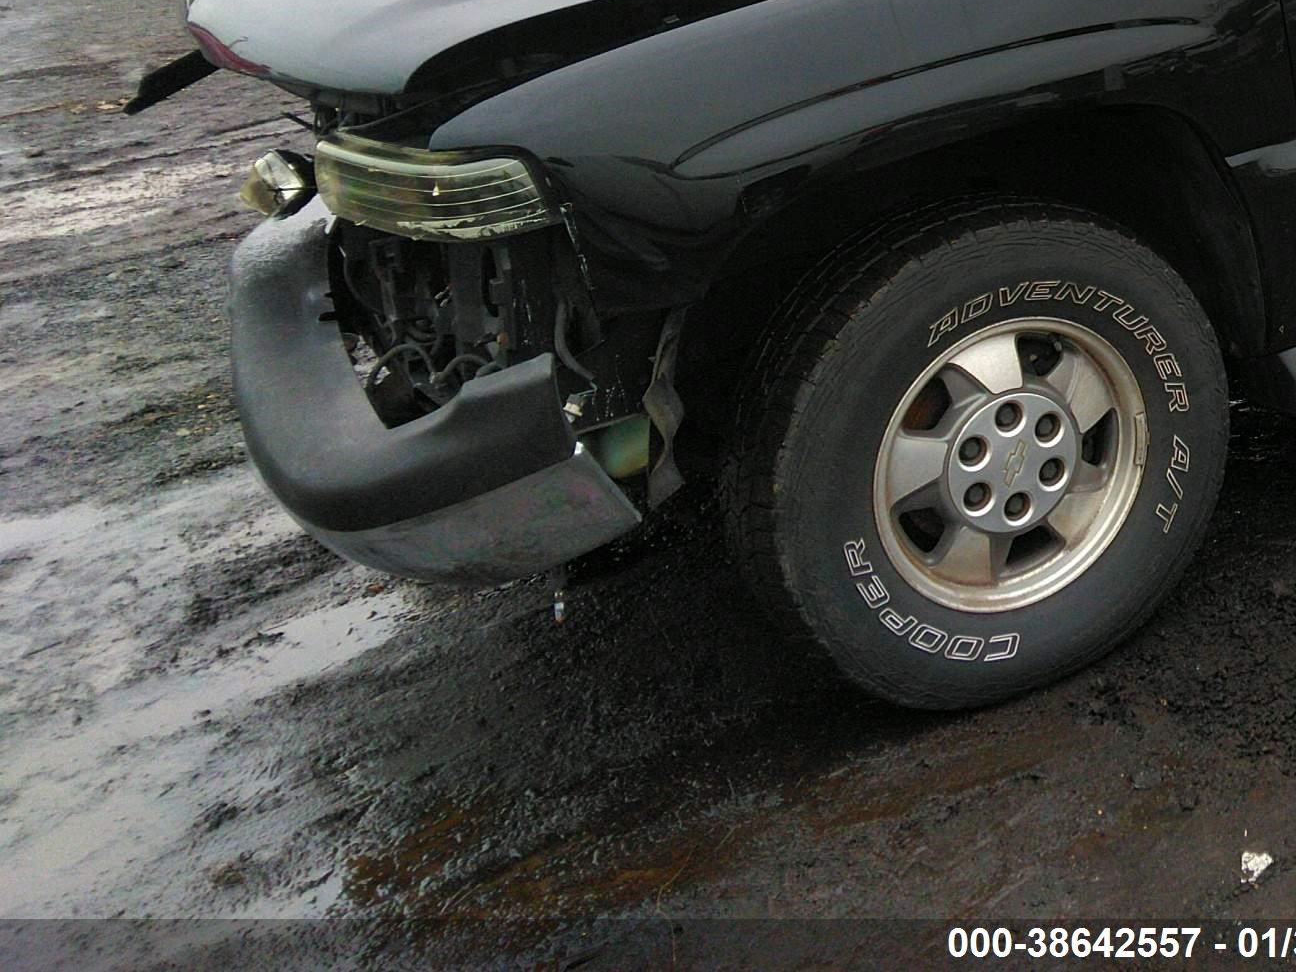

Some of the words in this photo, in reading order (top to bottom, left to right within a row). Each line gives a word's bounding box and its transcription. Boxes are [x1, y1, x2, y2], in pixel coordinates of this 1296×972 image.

[928, 280, 1190, 414] ADVENTURER
[1155, 434, 1191, 534] A/T
[843, 537, 1021, 662] COOPER
